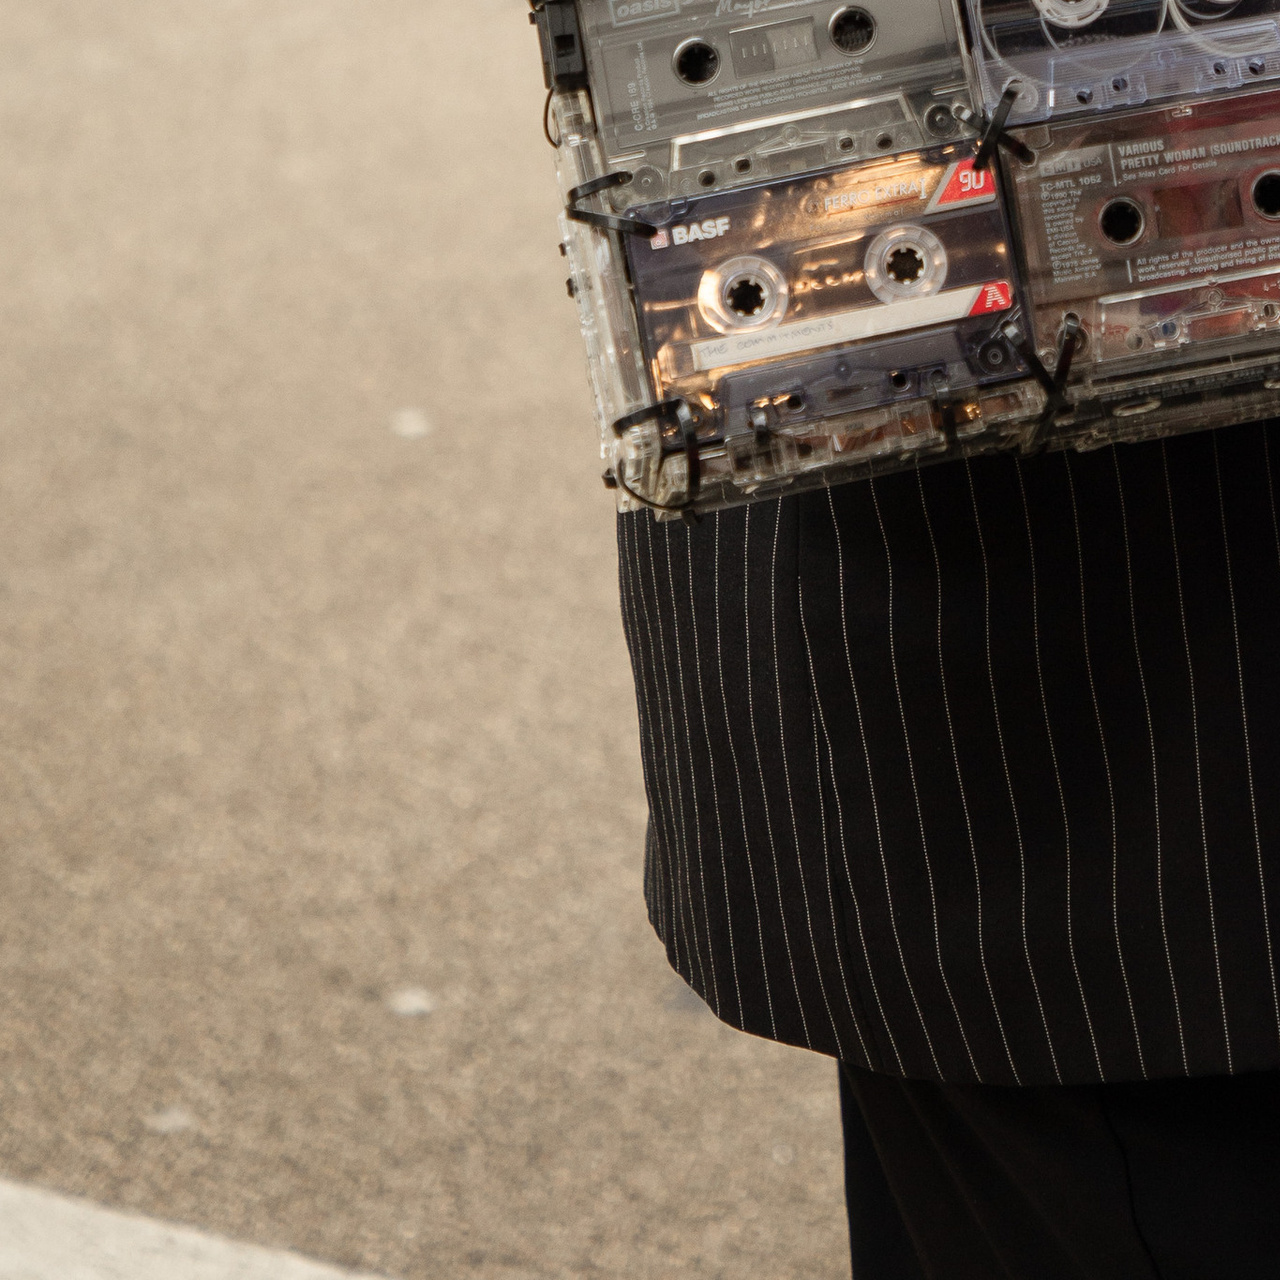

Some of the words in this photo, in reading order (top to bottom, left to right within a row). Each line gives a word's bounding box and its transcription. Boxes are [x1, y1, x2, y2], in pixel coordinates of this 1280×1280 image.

[1118, 139, 1164, 157] VARIOUS
[1120, 153, 1158, 170] PRETTY
[1164, 146, 1205, 163] WOMAN
[1082, 155, 1102, 168] USA
[824, 188, 870, 211] FERRO
[875, 178, 919, 200] EXTRA
[1040, 178, 1074, 192] TC-MTL
[1078, 174, 1102, 185] 1052
[672, 215, 730, 246] BASF
[1136, 257, 1146, 265] All
[1148, 254, 1168, 264] rights
[1171, 252, 1178, 260] of
[1181, 250, 1192, 258] the
[1196, 244, 1227, 257] producer
[1230, 242, 1243, 250] and
[1246, 239, 1258, 248] the
[1138, 264, 1154, 273] work
[1194, 250, 1242, 264] Unauthorised
[1244, 246, 1266, 257] public
[1190, 262, 1218, 274] copying
[1220, 259, 1234, 268] and
[1235, 256, 1256, 267] hiring
[1258, 254, 1266, 262] of
[1268, 252, 1280, 261] this
[984, 283, 1005, 308] A
[699, 341, 728, 359] THE
